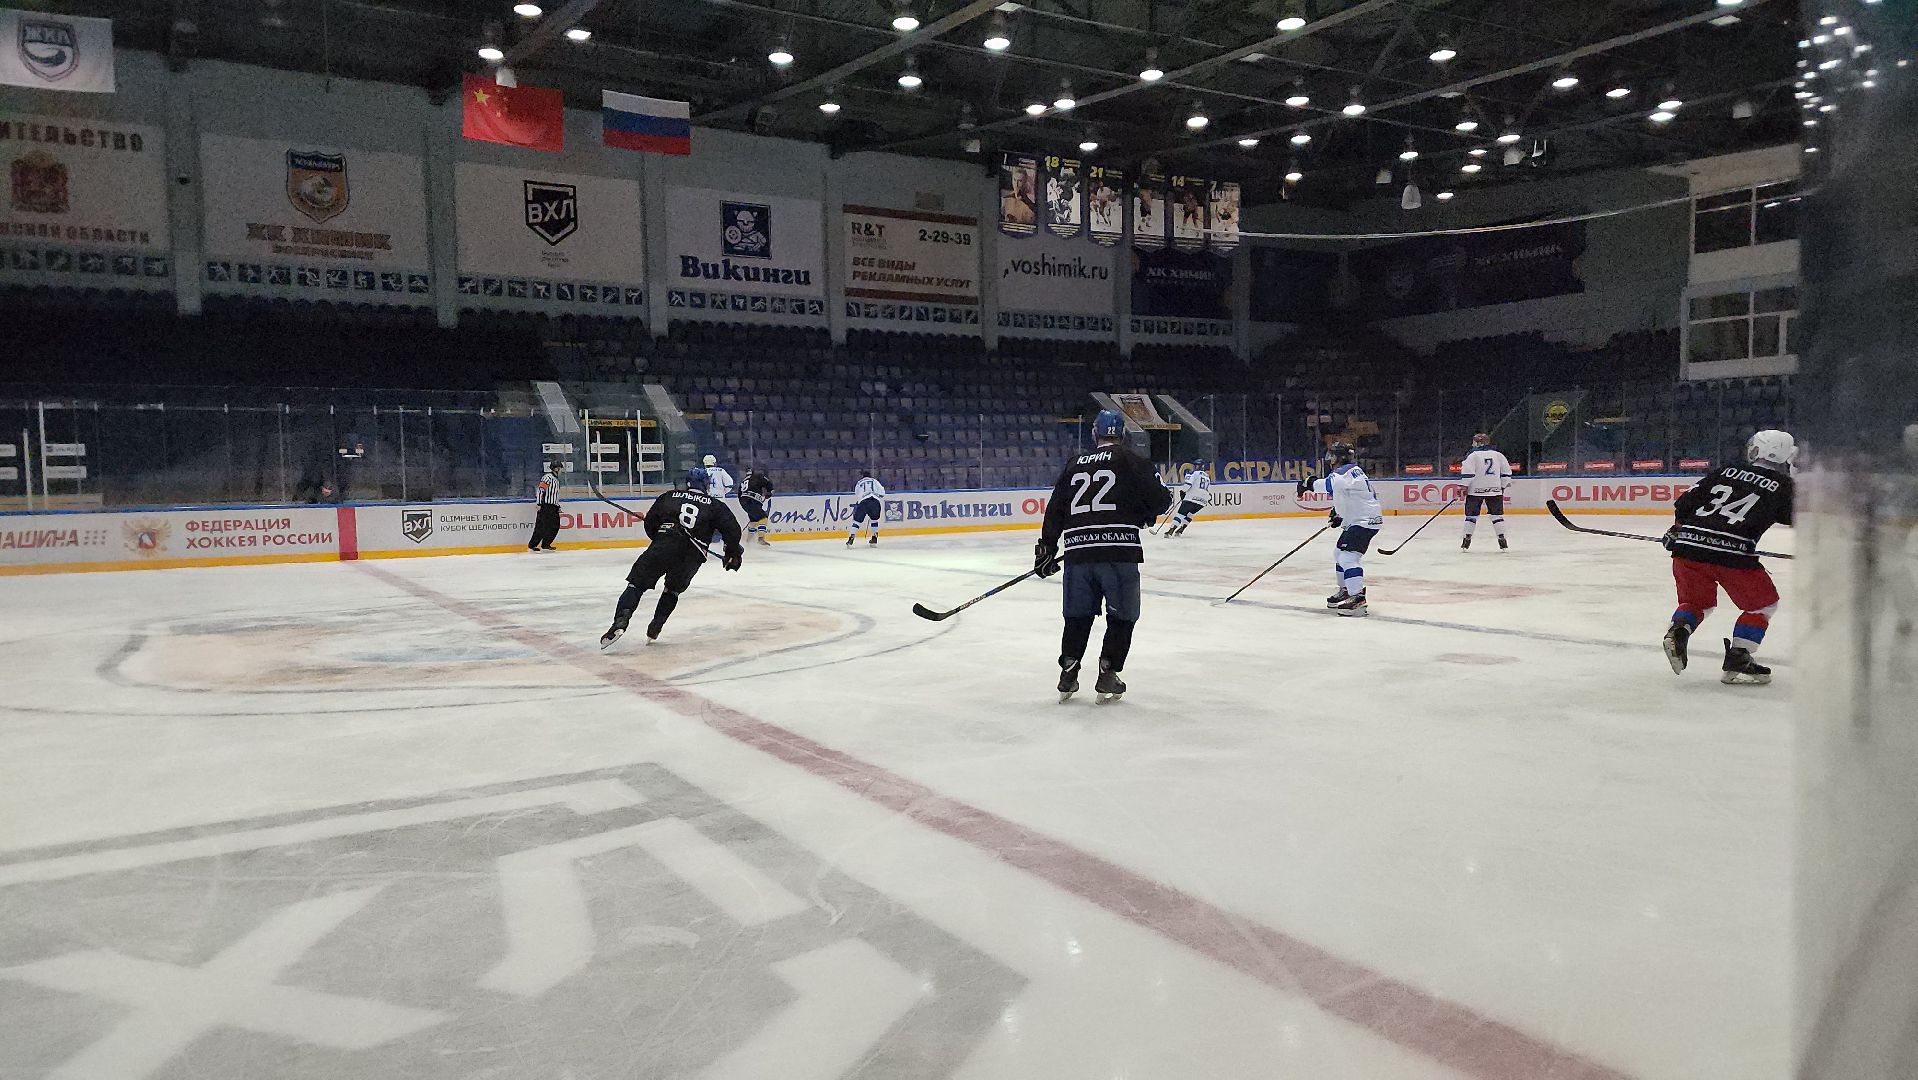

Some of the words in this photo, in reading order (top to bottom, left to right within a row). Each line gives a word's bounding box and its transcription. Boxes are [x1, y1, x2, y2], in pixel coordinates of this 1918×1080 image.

[1044, 155, 1060, 167] 18
[1171, 176, 1185, 187] 14
[527, 198, 575, 224] ВХЛ
[851, 222, 886, 238] R&T
[918, 229, 972, 246] 2-29-39
[680, 254, 811, 286] Викинги
[852, 256, 876, 267] ВСЕ
[878, 258, 915, 271] ВИДЫ
[852, 271, 934, 286] РЕКЛАМНЫХ
[936, 277, 973, 289] УСЛУГ
[1107, 426, 1117, 435] 22
[1076, 451, 1112, 465] ЮРИН
[1484, 458, 1494, 475] 2
[1223, 459, 1322, 482] СТРАНЫ
[1070, 469, 1117, 516] 22
[1552, 485, 1692, 502] OLIMPBE
[907, 499, 1013, 520] Викинги
[1695, 483, 1761, 525] 34
[559, 511, 645, 530] OLIMP
[678, 502, 699, 529] 8
[185, 518, 291, 533] ФЕДЕРАЦИЯ
[403, 516, 432, 534] ВХЛ
[440, 524, 469, 532] КУБОК
[186, 534, 258, 550] ХОККЕЯ
[262, 532, 333, 547] РОССИИ
